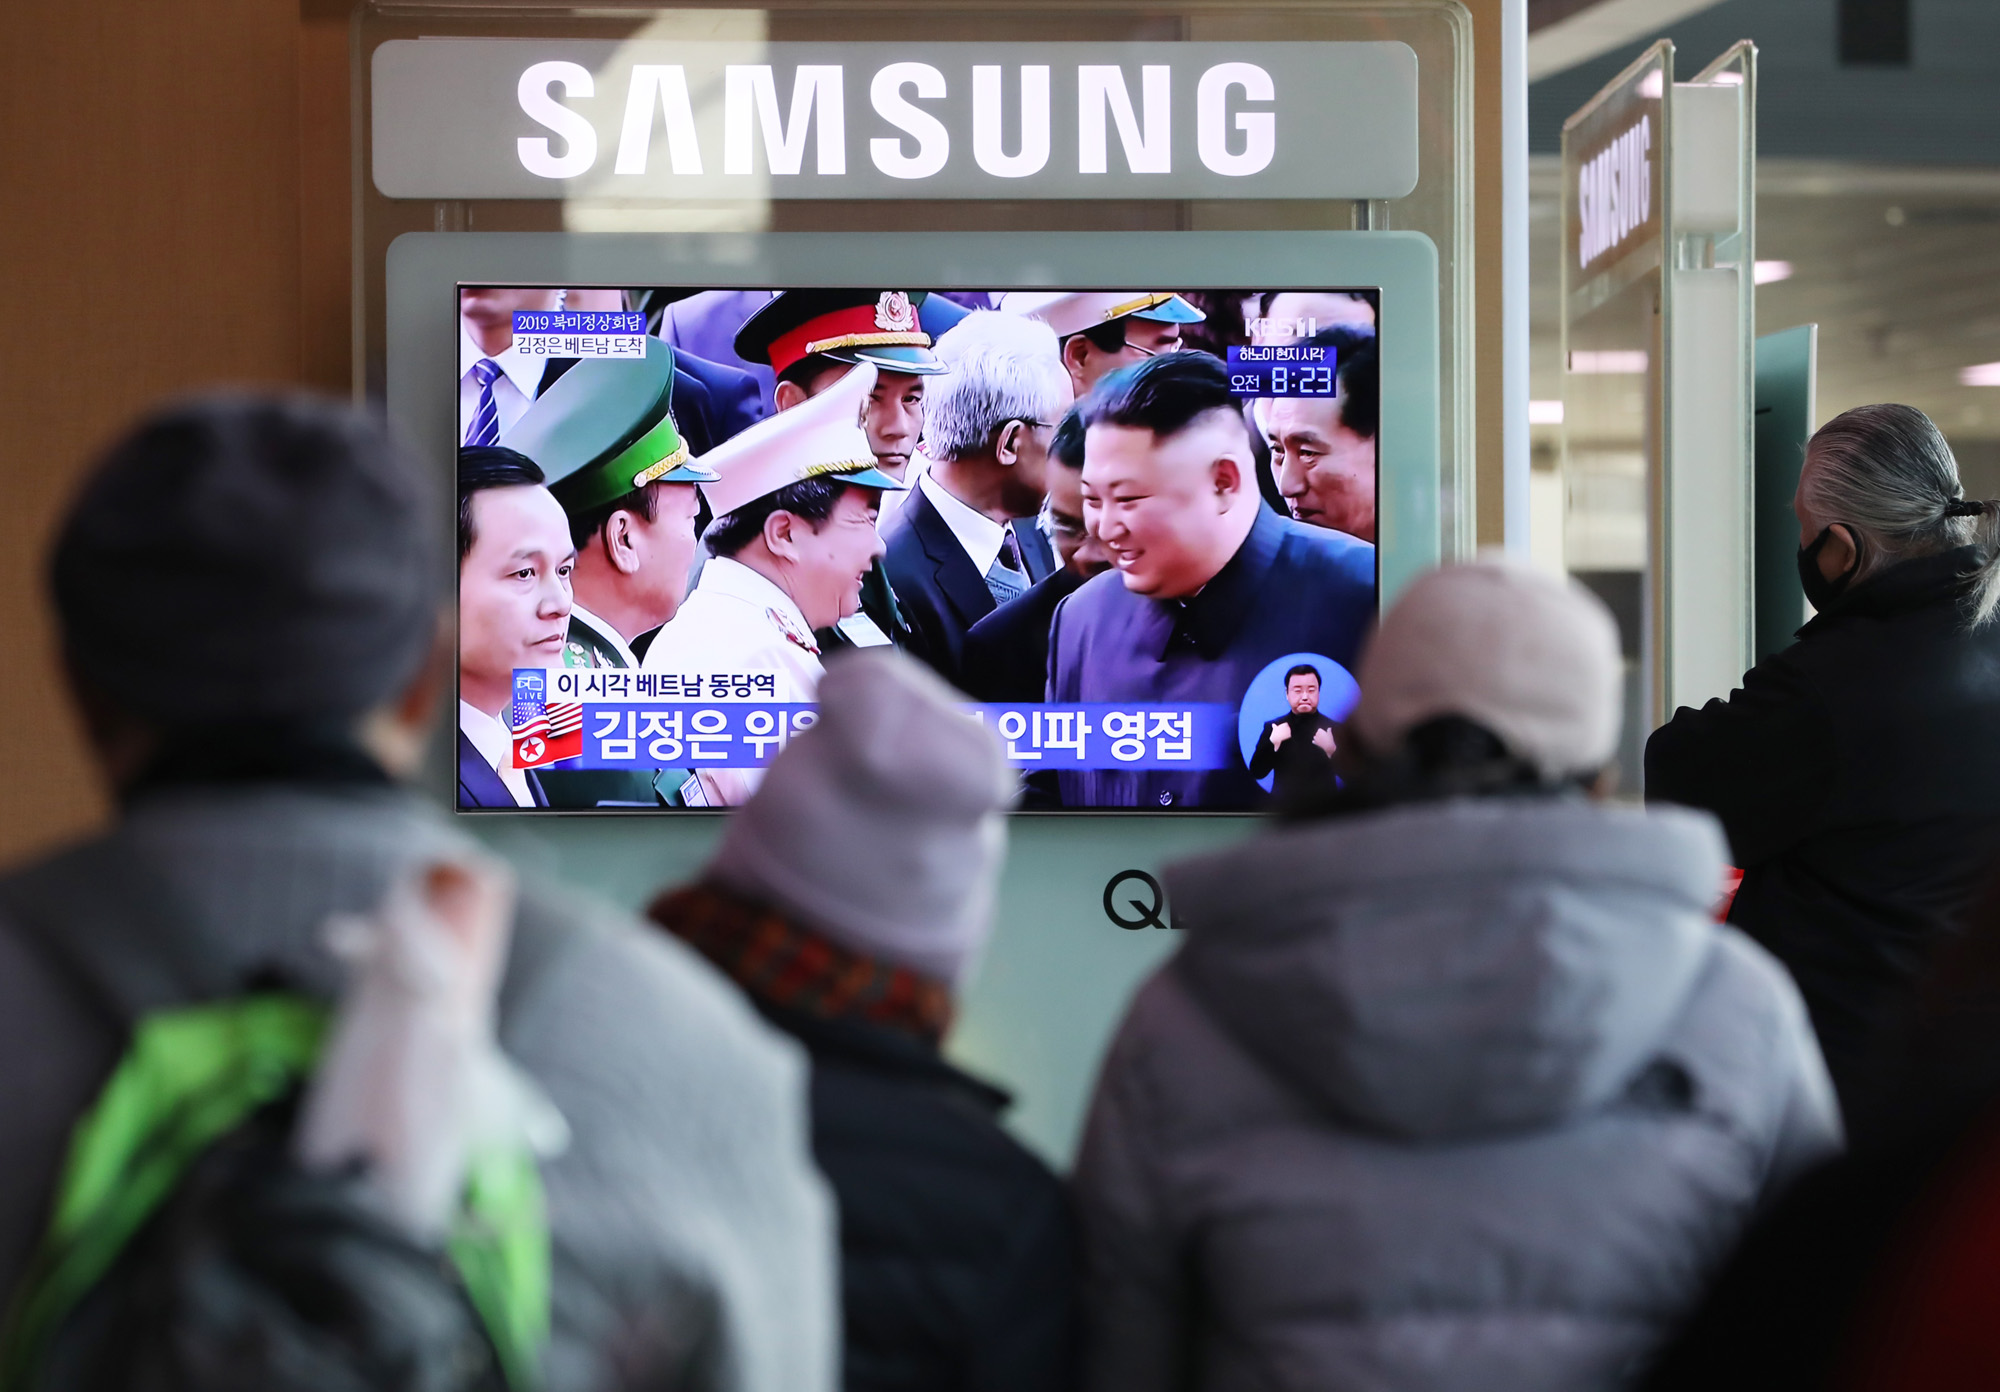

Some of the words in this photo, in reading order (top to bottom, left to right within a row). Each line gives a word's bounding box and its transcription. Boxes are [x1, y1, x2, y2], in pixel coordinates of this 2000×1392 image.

[516, 60, 1277, 180] SAMSUNG
[1578, 114, 1651, 270] SAMSUNG
[517, 315, 550, 330] 2019
[552, 313, 642, 332] 북미정상회담
[517, 336, 562, 355] 김정은
[564, 337, 610, 355] 베트남
[612, 337, 643, 355] 도착
[1239, 346, 1274, 361] 하노이
[1275, 347, 1299, 361] 현지
[1301, 347, 1325, 361] 시각
[1230, 375, 1260, 392] 오전
[1271, 366, 1332, 394] 8:23
[517, 691, 543, 700] LIVE
[557, 674, 579, 697] 이
[585, 674, 631, 697] 시각
[636, 674, 703, 697] 베트남
[708, 674, 776, 698] 동당역
[592, 709, 733, 761] 김정은
[998, 711, 1093, 760] 인파
[1101, 711, 1193, 761] 영접
